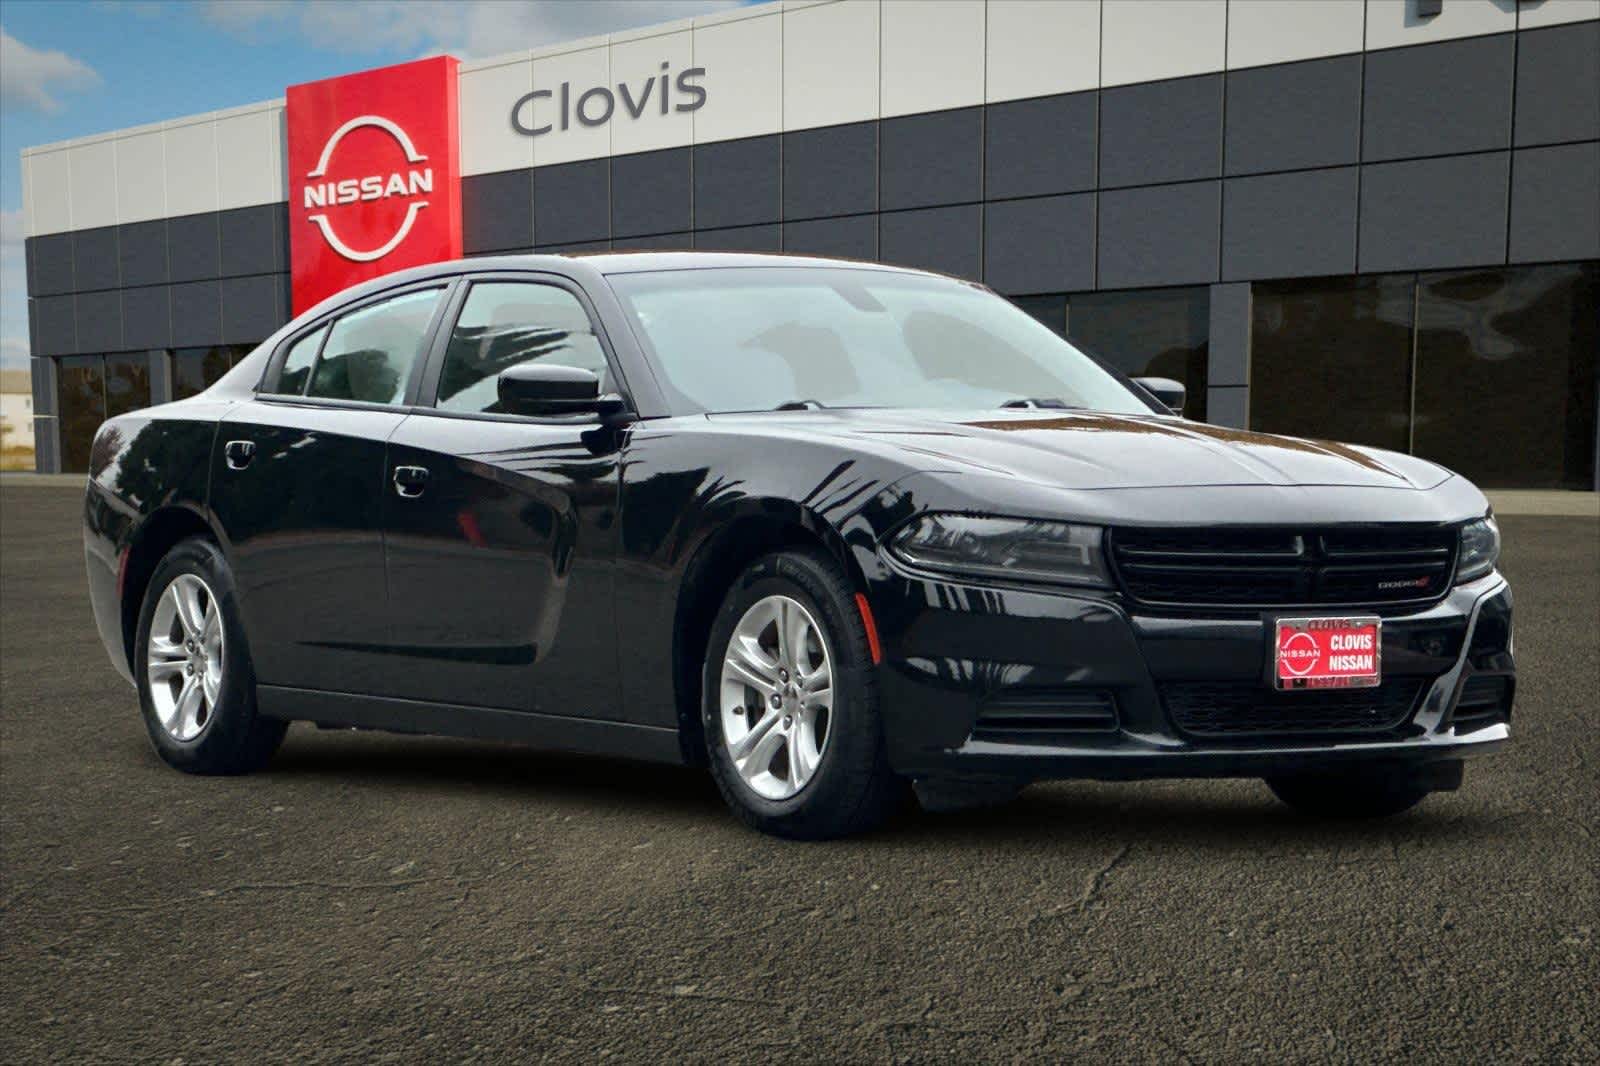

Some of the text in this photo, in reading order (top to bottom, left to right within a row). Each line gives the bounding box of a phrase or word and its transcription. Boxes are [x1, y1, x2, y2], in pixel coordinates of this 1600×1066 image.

[511, 61, 707, 137] Clovis
[303, 168, 433, 209] NISSAN
[1330, 634, 1373, 651] CLOVIS
[1280, 649, 1321, 658] NISSAN
[1329, 655, 1373, 671] NISSAN
